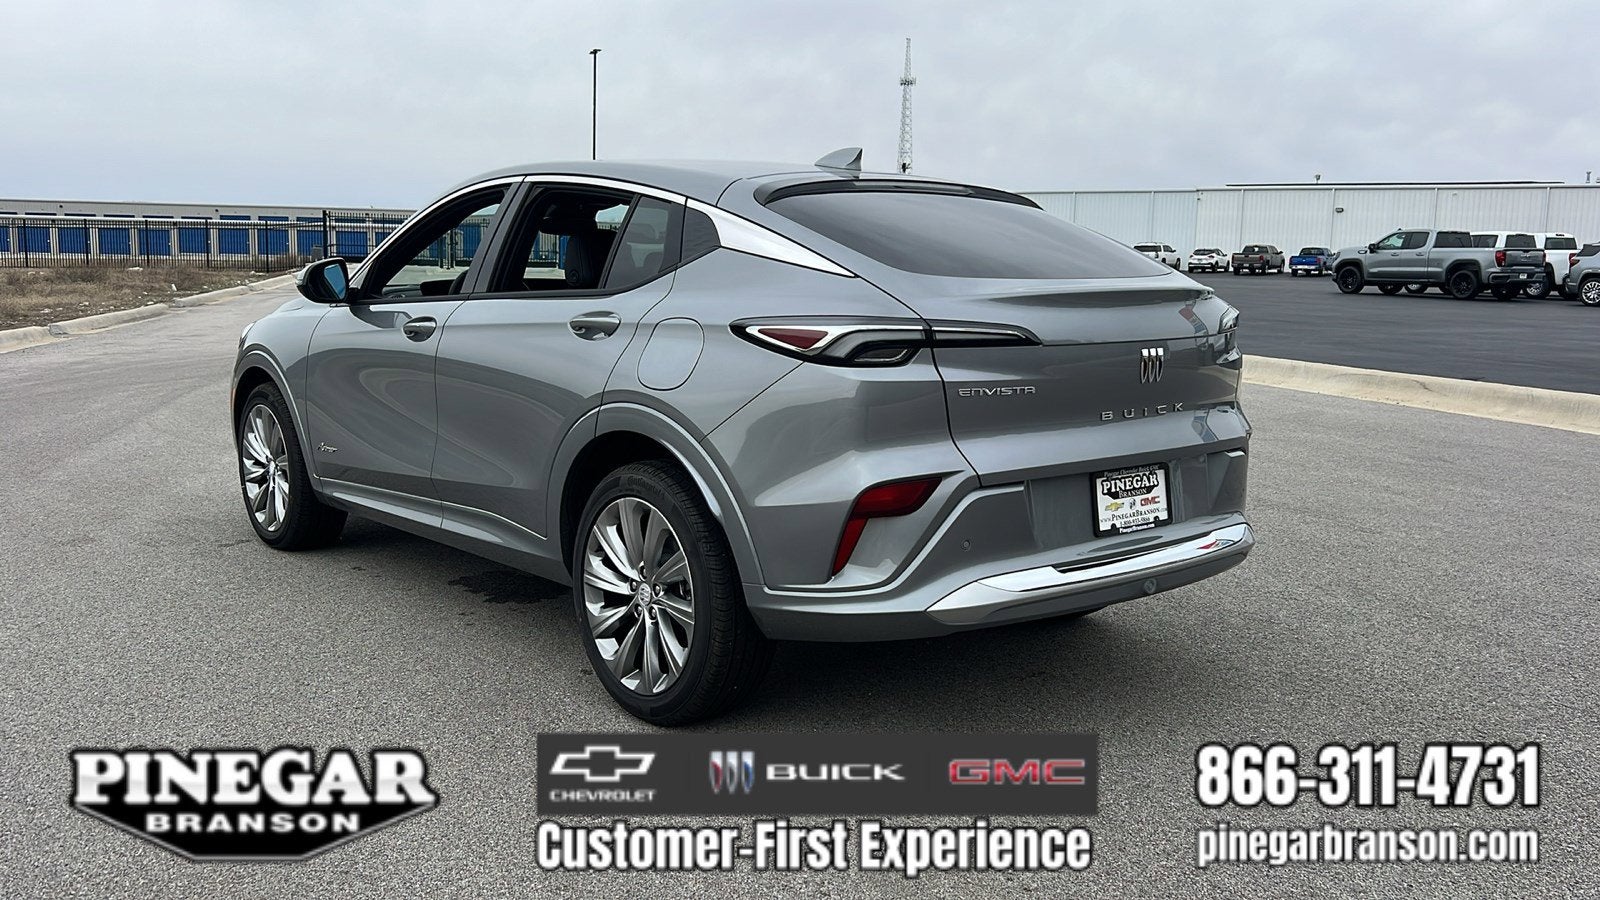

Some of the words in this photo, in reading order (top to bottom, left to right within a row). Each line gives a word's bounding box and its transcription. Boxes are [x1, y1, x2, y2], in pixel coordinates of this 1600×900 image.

[958, 386, 1036, 397] ENVISTA
[1101, 402, 1184, 421] BUICK
[1102, 474, 1158, 493] PINEGAR
[1119, 488, 1148, 498] BRANSON
[1140, 496, 1160, 507] GMC
